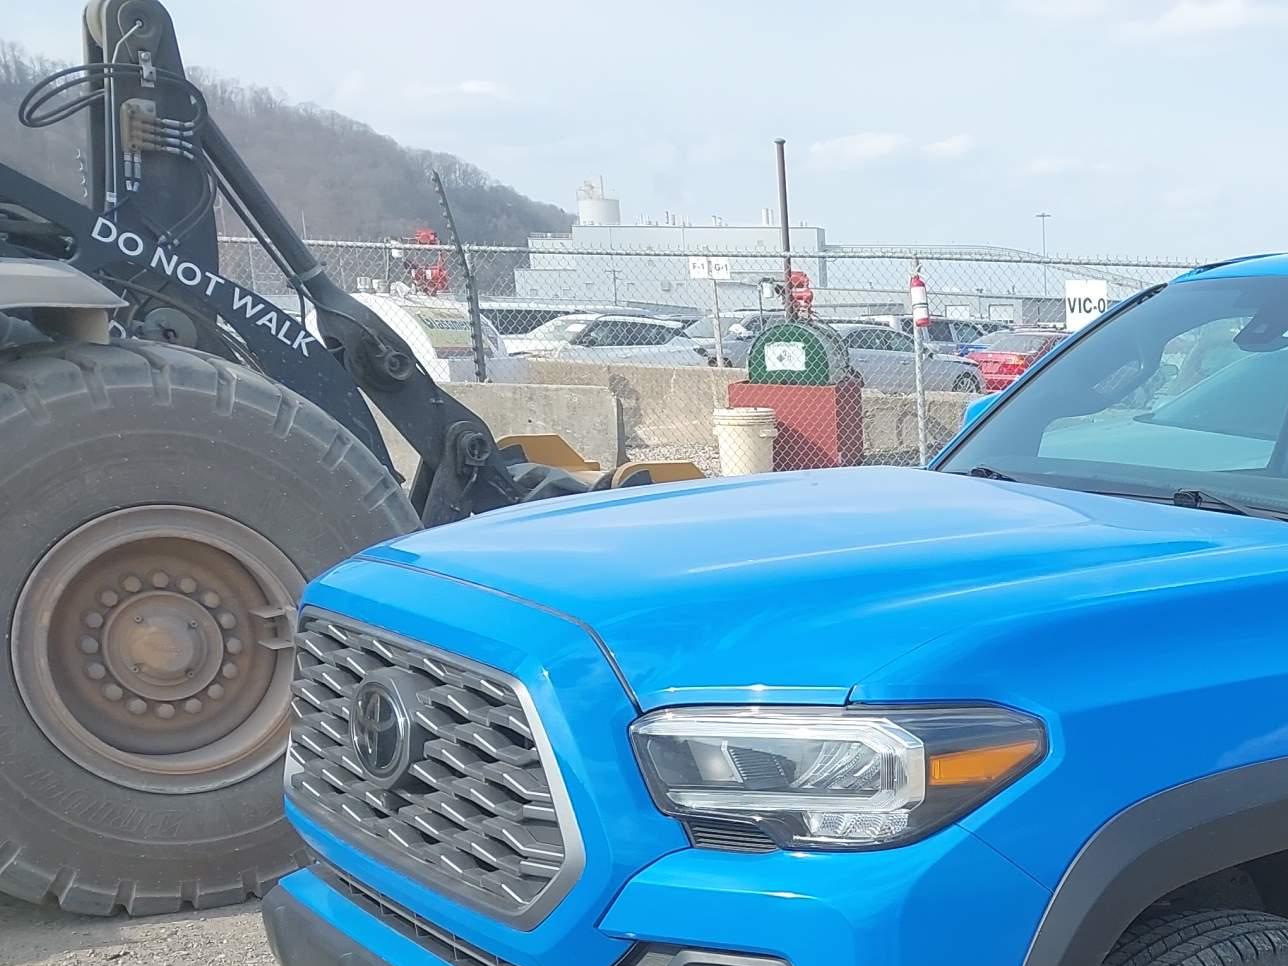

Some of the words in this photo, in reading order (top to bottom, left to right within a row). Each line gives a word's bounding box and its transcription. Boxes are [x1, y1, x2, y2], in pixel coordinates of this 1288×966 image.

[91, 216, 144, 256] DO
[150, 246, 225, 297] NOT
[232, 287, 316, 357] WALK
